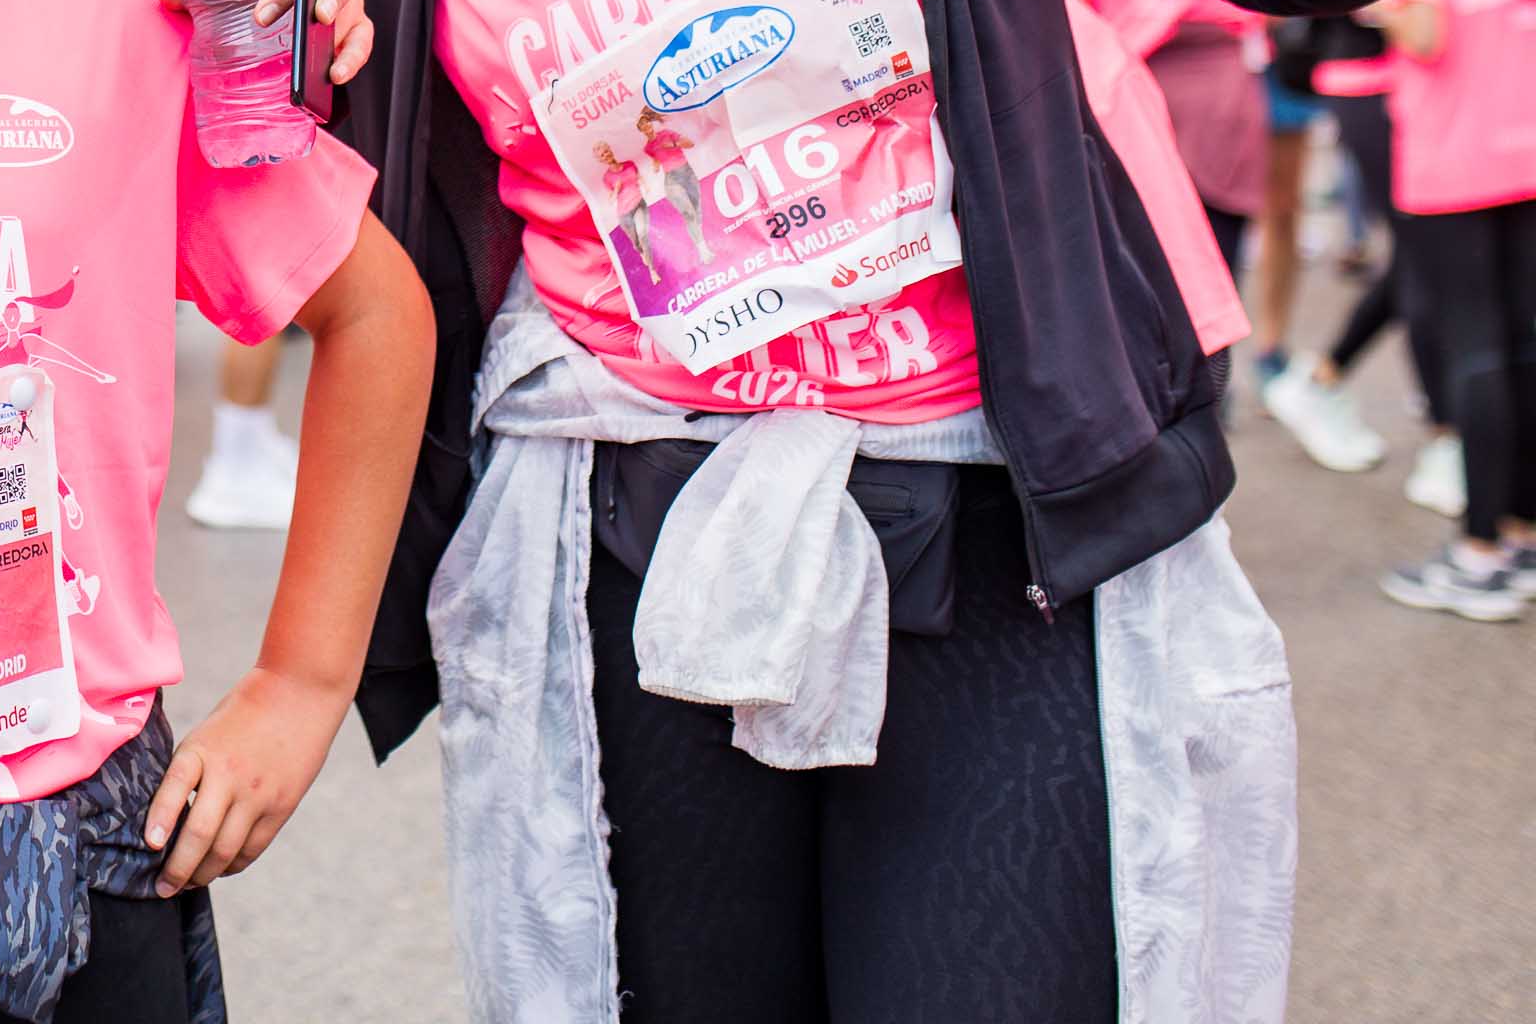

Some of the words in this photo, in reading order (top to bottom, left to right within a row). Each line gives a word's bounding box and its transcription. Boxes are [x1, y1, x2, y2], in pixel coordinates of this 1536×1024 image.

[571, 81, 634, 129] SUMA
[656, 24, 786, 108] ASTURIANA
[852, 65, 889, 89] MADRID
[713, 123, 840, 219] 016
[667, 266, 738, 315] CARRERA
[743, 253, 769, 274] DE
[794, 218, 860, 261] MUJER
[869, 180, 936, 222] MADRID
